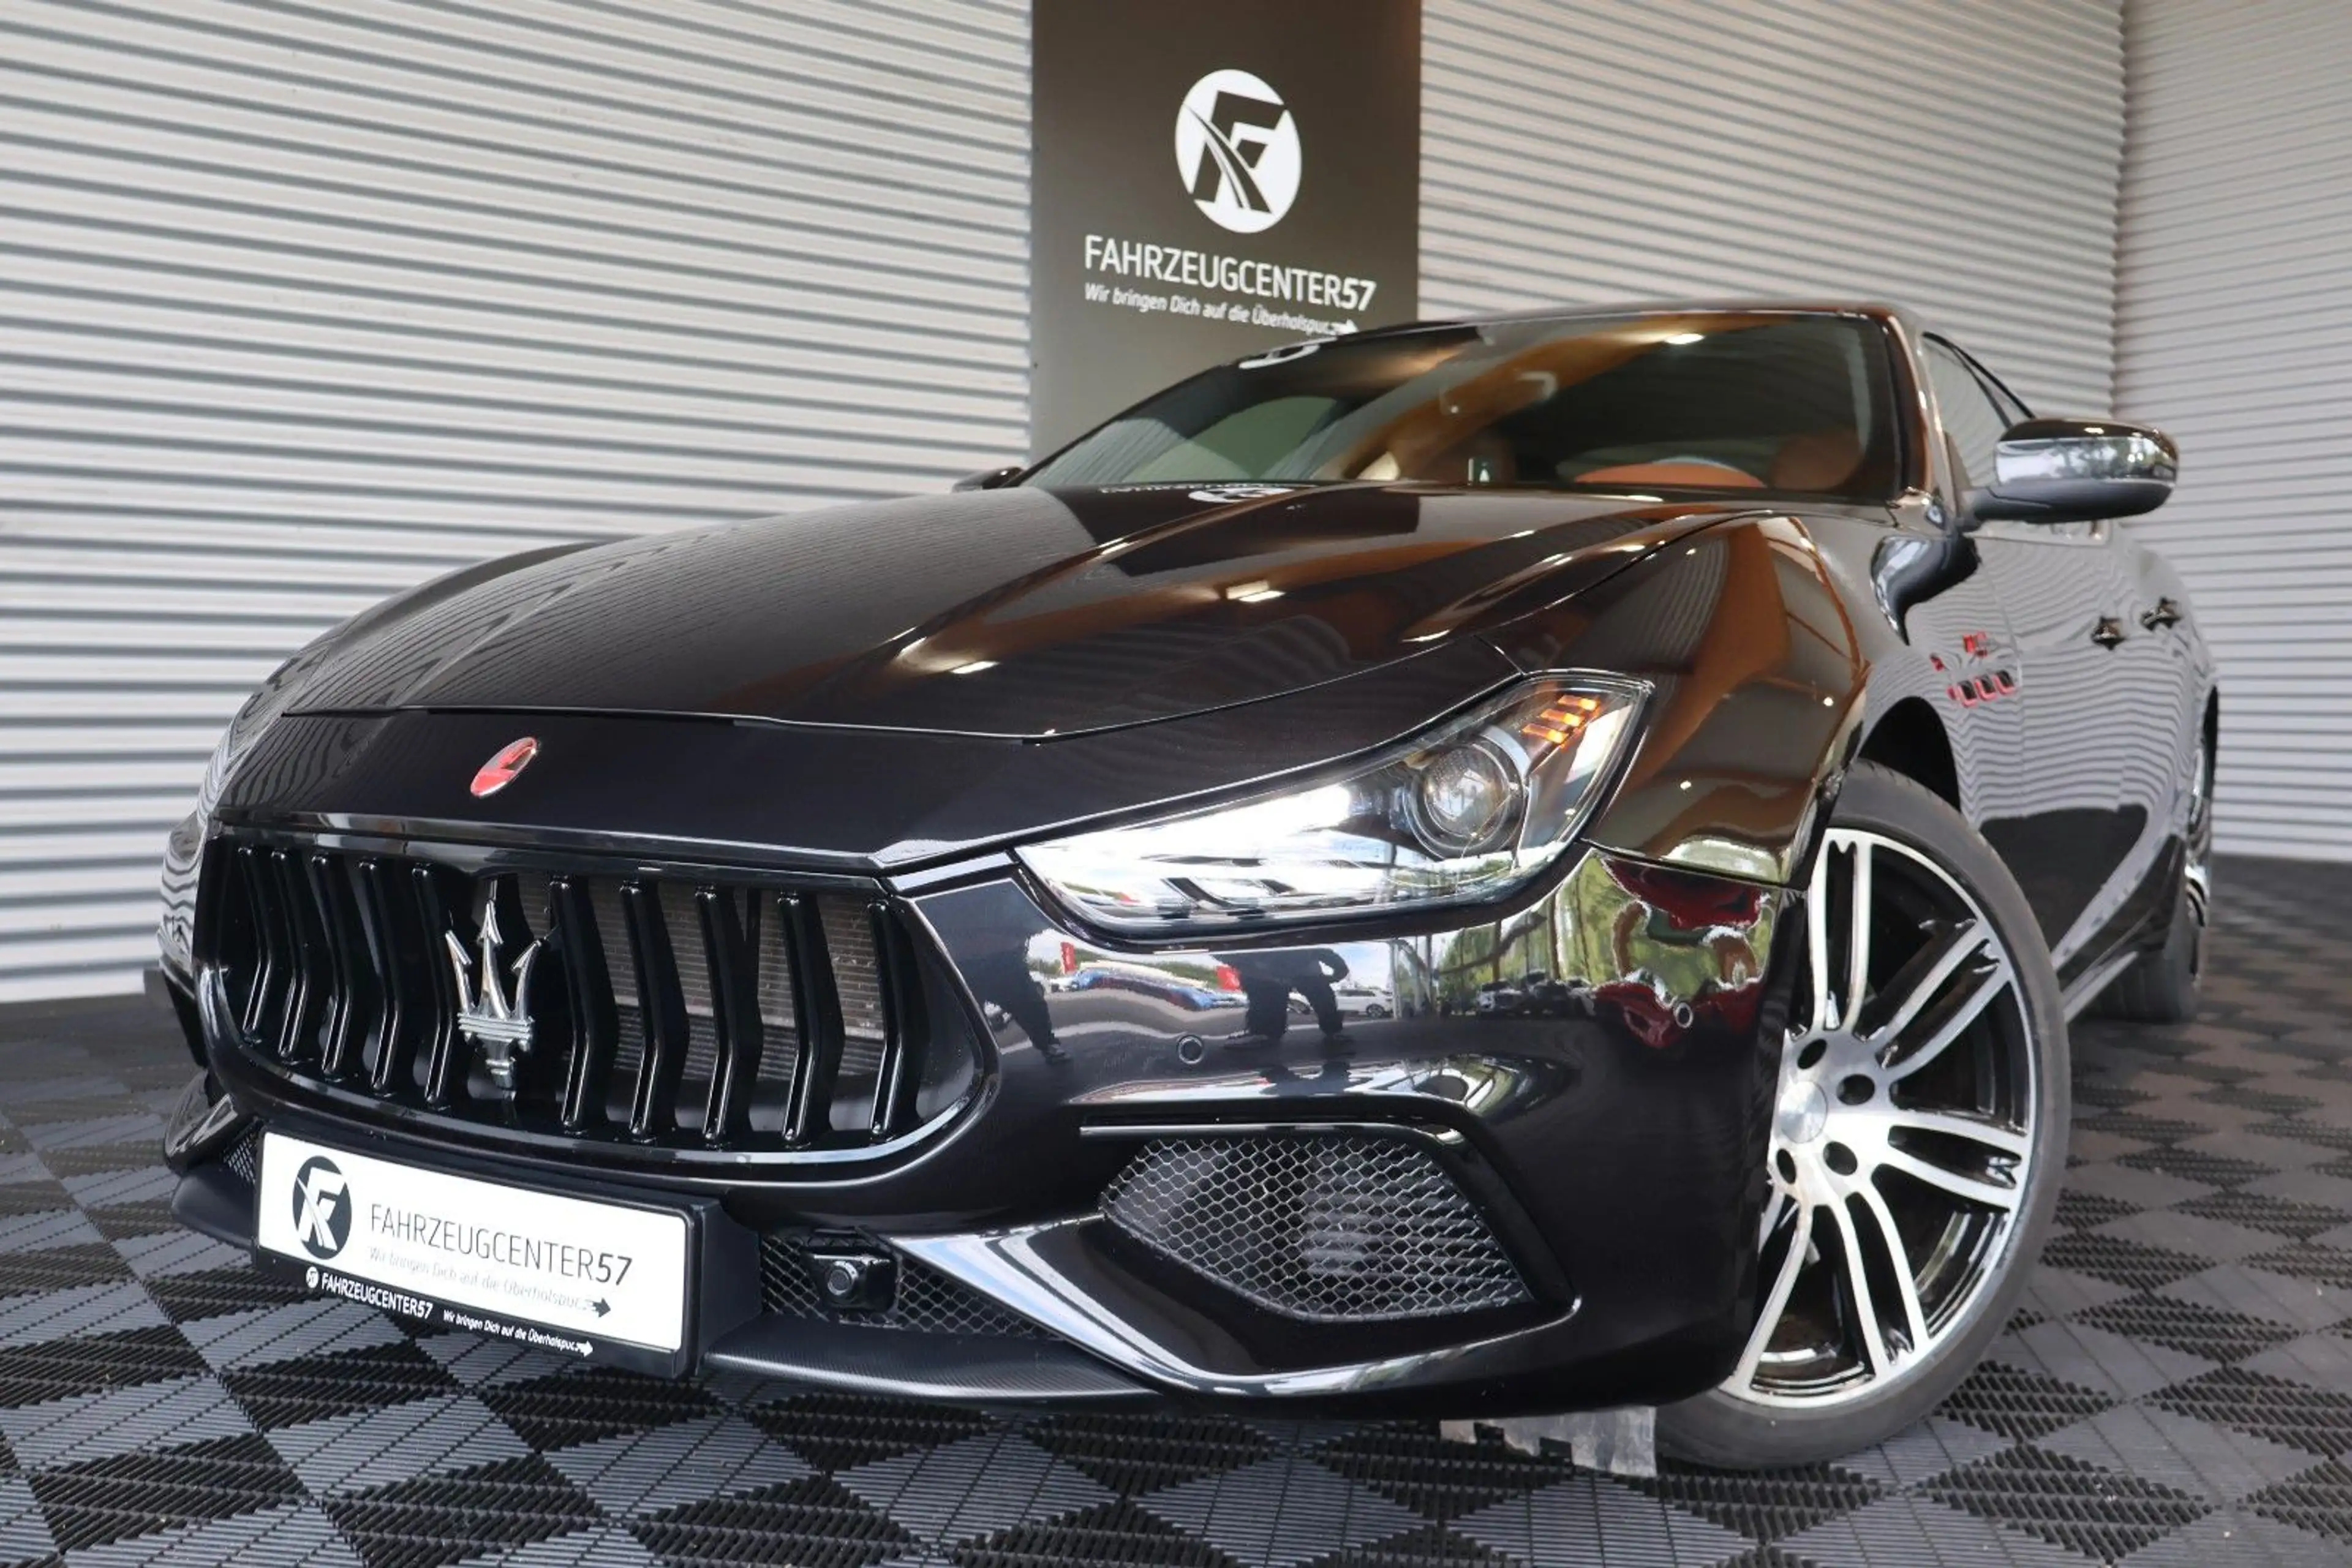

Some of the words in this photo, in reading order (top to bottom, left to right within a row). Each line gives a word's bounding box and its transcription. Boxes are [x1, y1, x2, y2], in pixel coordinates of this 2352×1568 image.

[1084, 234, 1377, 311] FAHRZEUGCENTER57
[1084, 282, 1110, 302] Wir
[1112, 287, 1167, 312] bringen
[1169, 295, 1200, 316] Dich
[1202, 302, 1228, 320] auf
[1227, 304, 1250, 323] die
[371, 1203, 633, 1286] FAHRZEUGCENTER57
[321, 1272, 434, 1320] FAHRZEUGCENTER57
[443, 1309, 456, 1324] Wir
[456, 1313, 483, 1331] bringen
[483, 1319, 501, 1335] Dich
